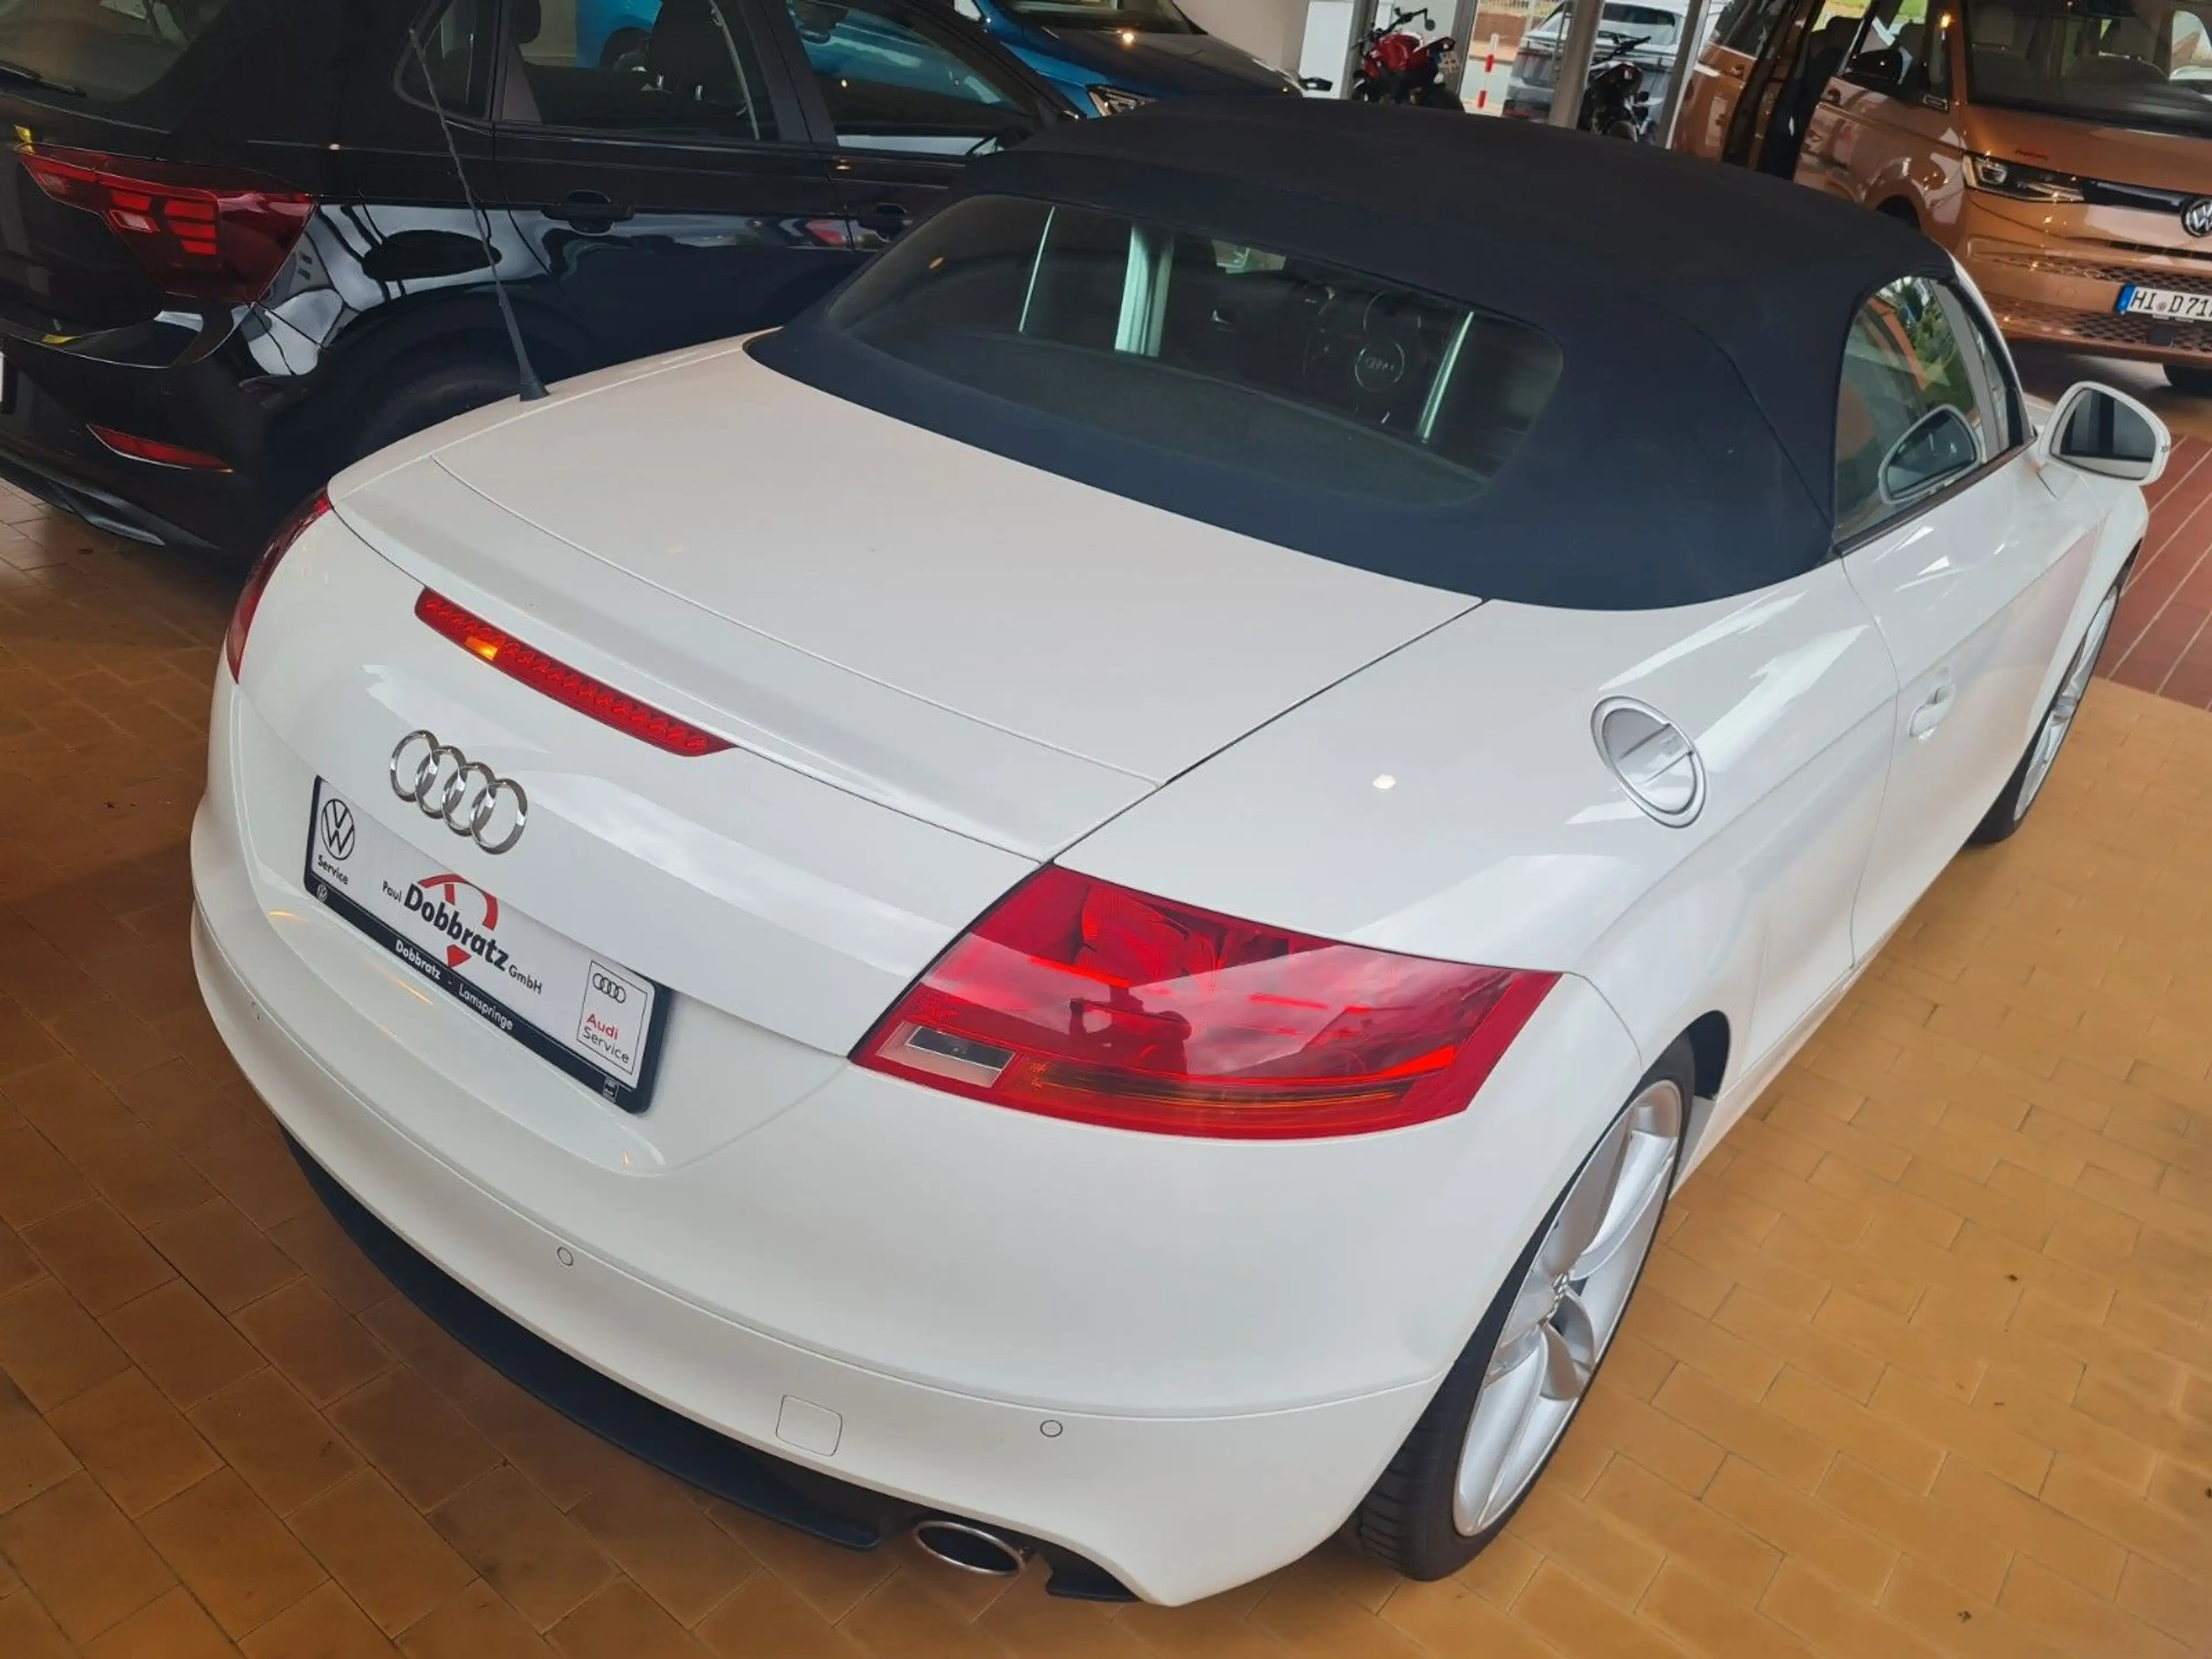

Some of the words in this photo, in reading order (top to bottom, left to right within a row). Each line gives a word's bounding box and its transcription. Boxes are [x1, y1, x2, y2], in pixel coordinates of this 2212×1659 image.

[2130, 290, 2157, 310] HI
[2186, 297, 2212, 317] 71
[321, 798, 355, 860] VW
[317, 854, 349, 885] Service
[382, 880, 402, 902] Paul
[403, 883, 510, 971] Dobbratz
[509, 964, 543, 995] GmbH
[395, 940, 442, 980] Dobbratz
[459, 983, 513, 1030] Lamspringe
[582, 1026, 630, 1064] Service
[586, 1013, 619, 1040] Audi
